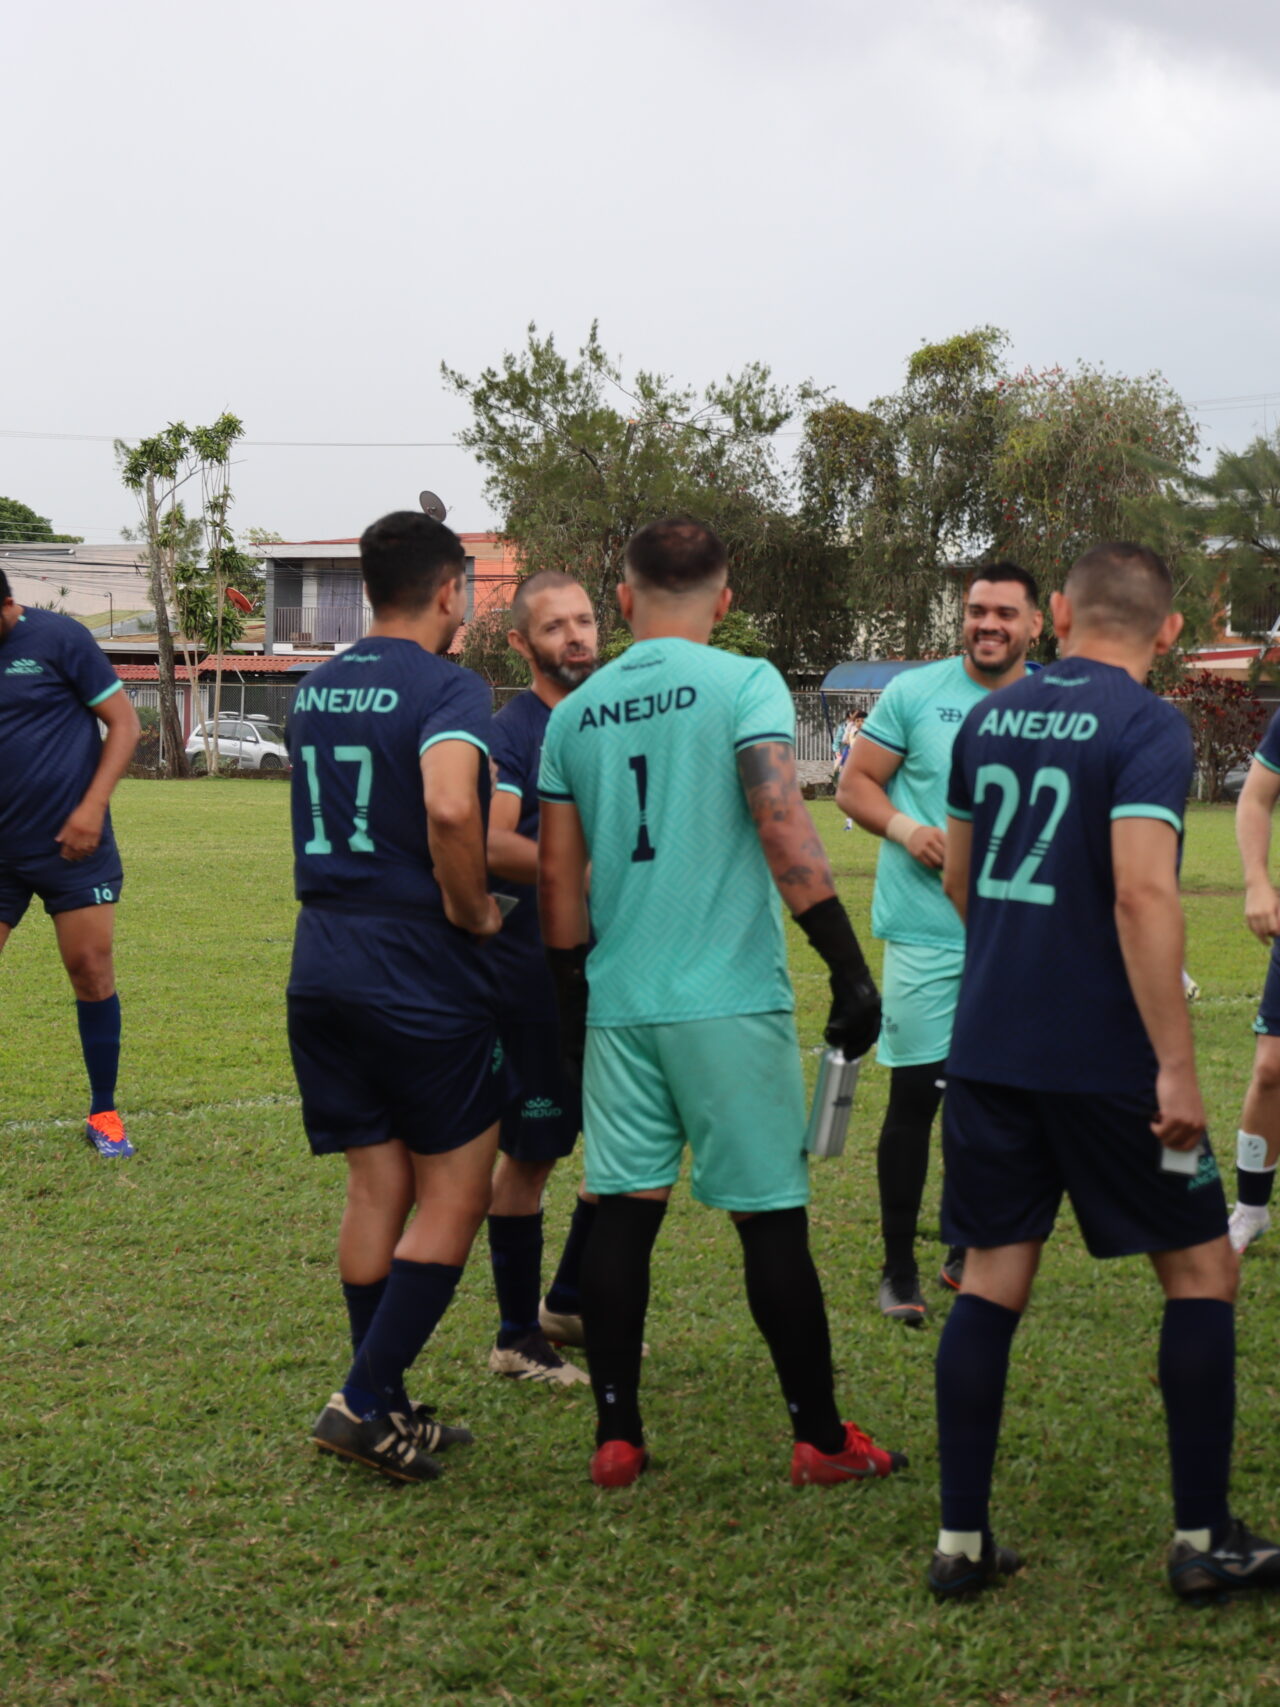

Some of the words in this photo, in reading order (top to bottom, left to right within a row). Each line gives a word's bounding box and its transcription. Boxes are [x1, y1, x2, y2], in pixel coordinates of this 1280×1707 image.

[294, 686, 399, 713] ANEJUD
[579, 686, 697, 733] ANEJUD
[977, 708, 1098, 741] ANEJUD
[301, 745, 375, 854] 17
[628, 754, 656, 862] 1
[974, 763, 1070, 906] 22
